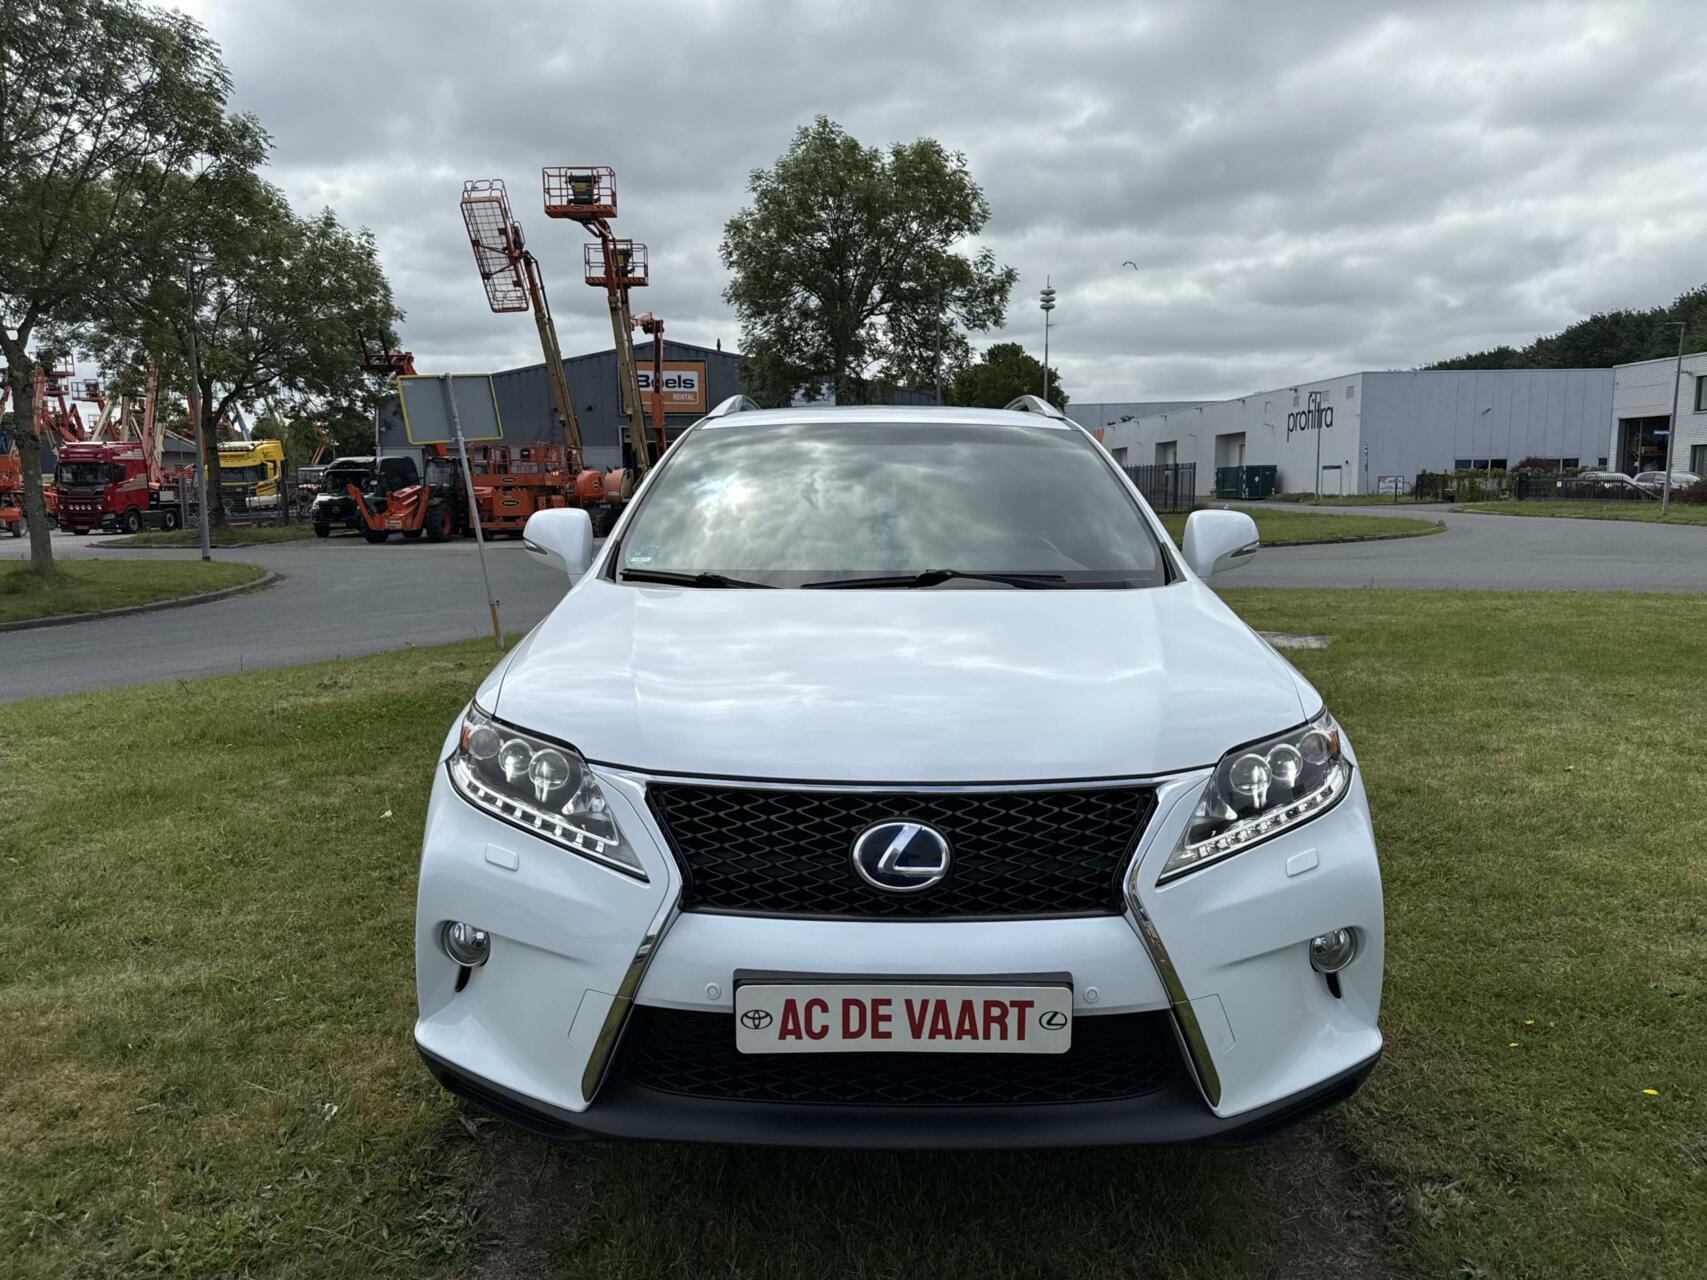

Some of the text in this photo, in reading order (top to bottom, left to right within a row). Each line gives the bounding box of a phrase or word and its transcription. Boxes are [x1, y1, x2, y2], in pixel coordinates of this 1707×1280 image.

[672, 393, 695, 401] RENTAL
[778, 998, 1035, 1042] AC DE VAART
